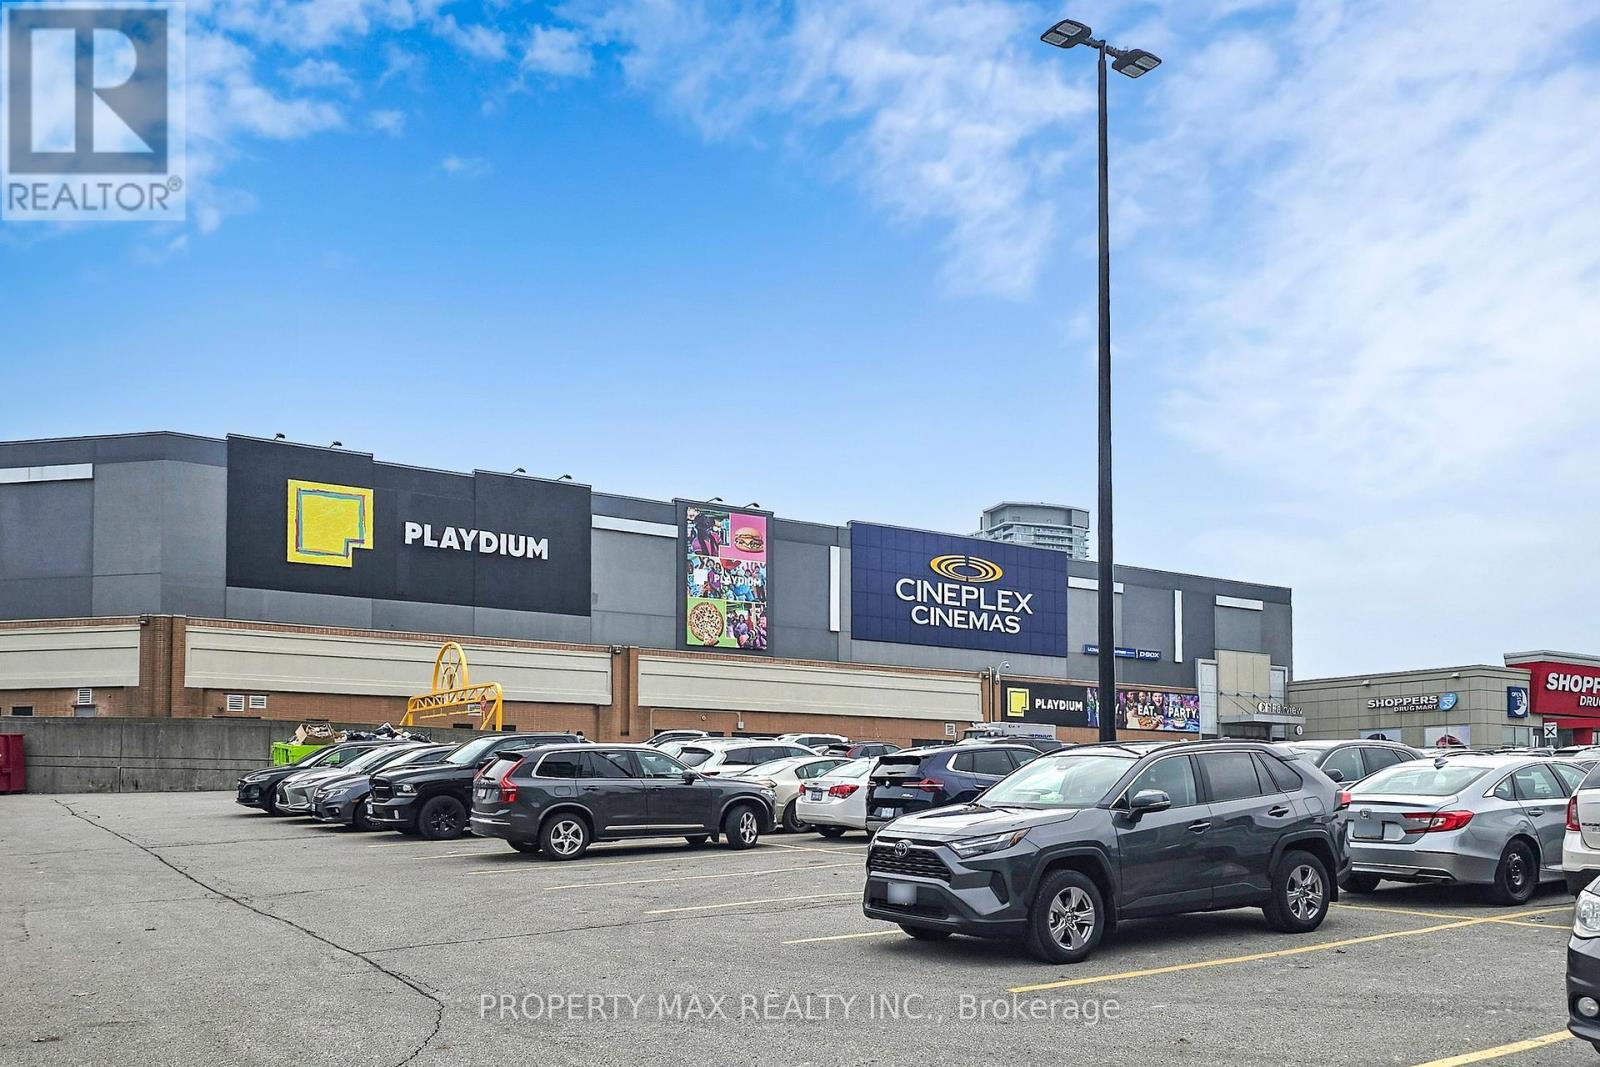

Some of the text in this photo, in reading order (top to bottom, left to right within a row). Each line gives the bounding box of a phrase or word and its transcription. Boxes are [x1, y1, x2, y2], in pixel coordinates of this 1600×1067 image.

[404, 521, 549, 560] PLAYDIUM
[895, 577, 1034, 615] CINEPLEX
[910, 605, 1022, 634] CINEMAS
[1035, 698, 1083, 712] PLAYDIUM
[1367, 695, 1438, 708] SHOPPERS
[1580, 695, 1600, 707] DRU
[1137, 704, 1199, 718] EAT. PARTY.
